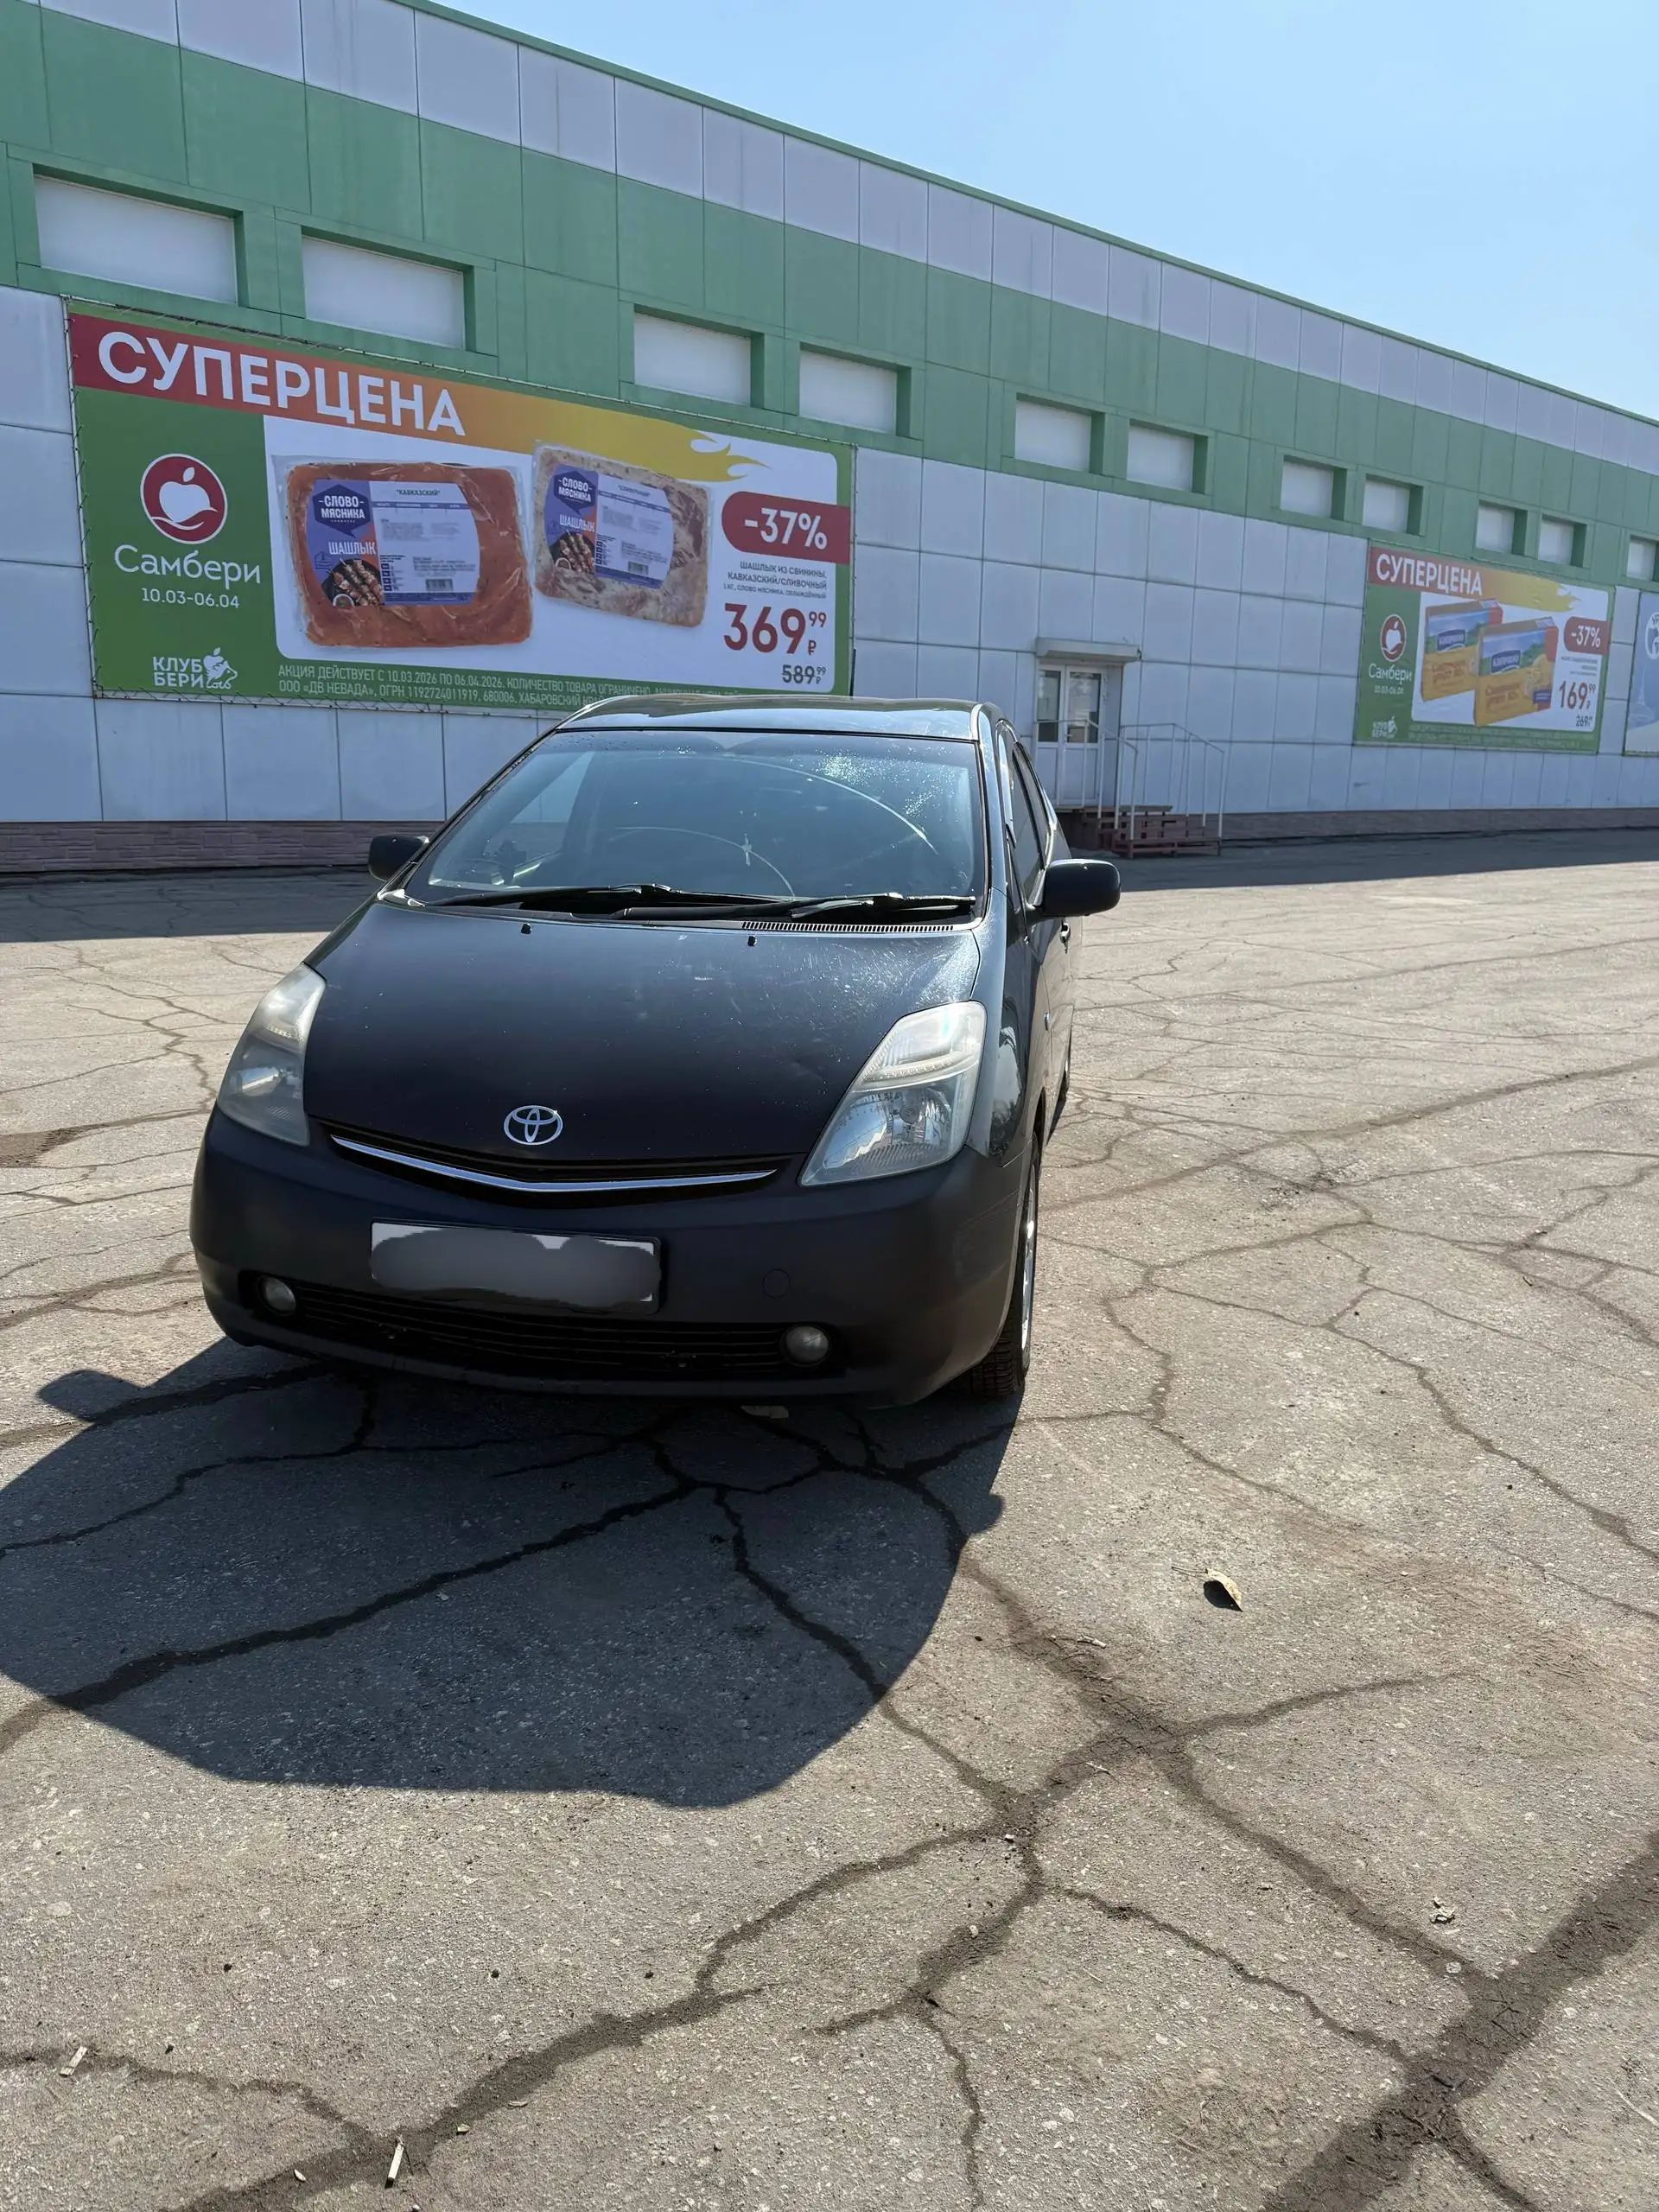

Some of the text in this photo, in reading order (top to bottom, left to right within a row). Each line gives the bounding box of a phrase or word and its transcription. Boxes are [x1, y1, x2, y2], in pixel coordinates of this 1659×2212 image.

[97, 331, 466, 435] СУПЕРЦЕНА
[321, 507, 365, 519] МЯСНИКА
[744, 507, 828, 550] -37%
[328, 541, 376, 555] ШАШЛЫК
[114, 544, 261, 590] Самбери
[740, 561, 778, 573] ШАШЛЫК
[1376, 553, 1483, 596] СУПЕРЦЕНА
[142, 588, 240, 608] 10.03-06.04
[723, 603, 806, 654] 369
[808, 611, 827, 628] 99
[1571, 625, 1601, 648] -37%
[152, 656, 202, 672] КЛУБ
[781, 664, 815, 684] 589
[1368, 663, 1413, 685] Самбери
[153, 671, 204, 689] БЕРИ
[278, 664, 315, 678] АКЦИЯ
[317, 664, 375, 682] ДЕЙСТВУЕТ
[378, 671, 385, 682] С
[388, 671, 437, 684] 10.03.2026
[439, 674, 453, 685] ПО
[454, 674, 505, 689] 06.04.2026.
[507, 678, 563, 692] КОЛИЧЕСТВО
[564, 681, 596, 694] ТОВАРА
[279, 680, 301, 692] ООО
[303, 681, 324, 695] «ДВ
[327, 682, 378, 697] НЕВАДА»,
[379, 684, 405, 697] ОГРН
[518, 692, 582, 707] ХАБАРОВСКИЙ
[1559, 680, 1588, 709] 169
